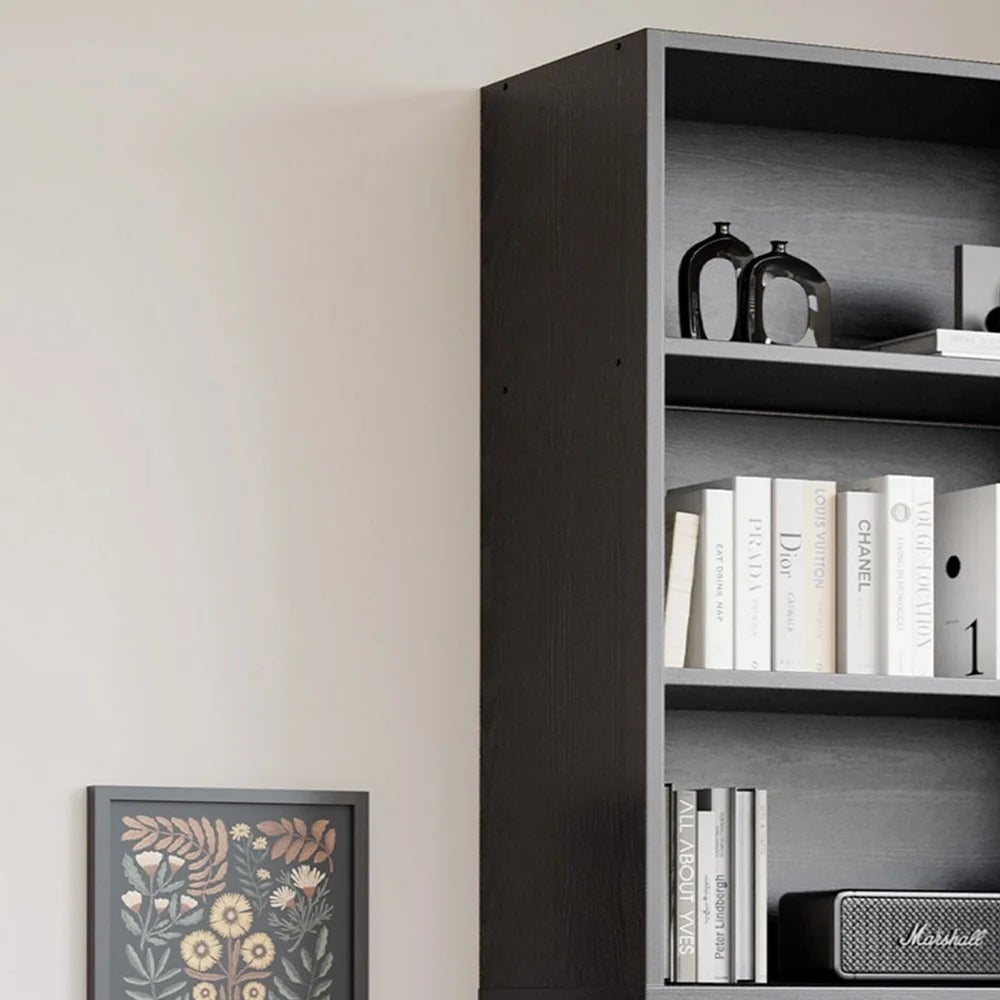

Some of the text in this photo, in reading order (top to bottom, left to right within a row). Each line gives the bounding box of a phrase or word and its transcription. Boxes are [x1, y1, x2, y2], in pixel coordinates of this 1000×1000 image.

[814, 488, 827, 528] LOUIS
[716, 566, 724, 597] DRINK
[748, 518, 763, 592] PRADA
[779, 532, 803, 578] Dior
[813, 531, 826, 589] VUITTON
[858, 519, 872, 593] CHANEL
[716, 601, 724, 623] NAP
[964, 617, 985, 677] 1
[679, 799, 695, 956] ALL ABOUT YVES
[714, 874, 728, 960] Peter Lindbergh
[900, 922, 987, 947] Marshall
